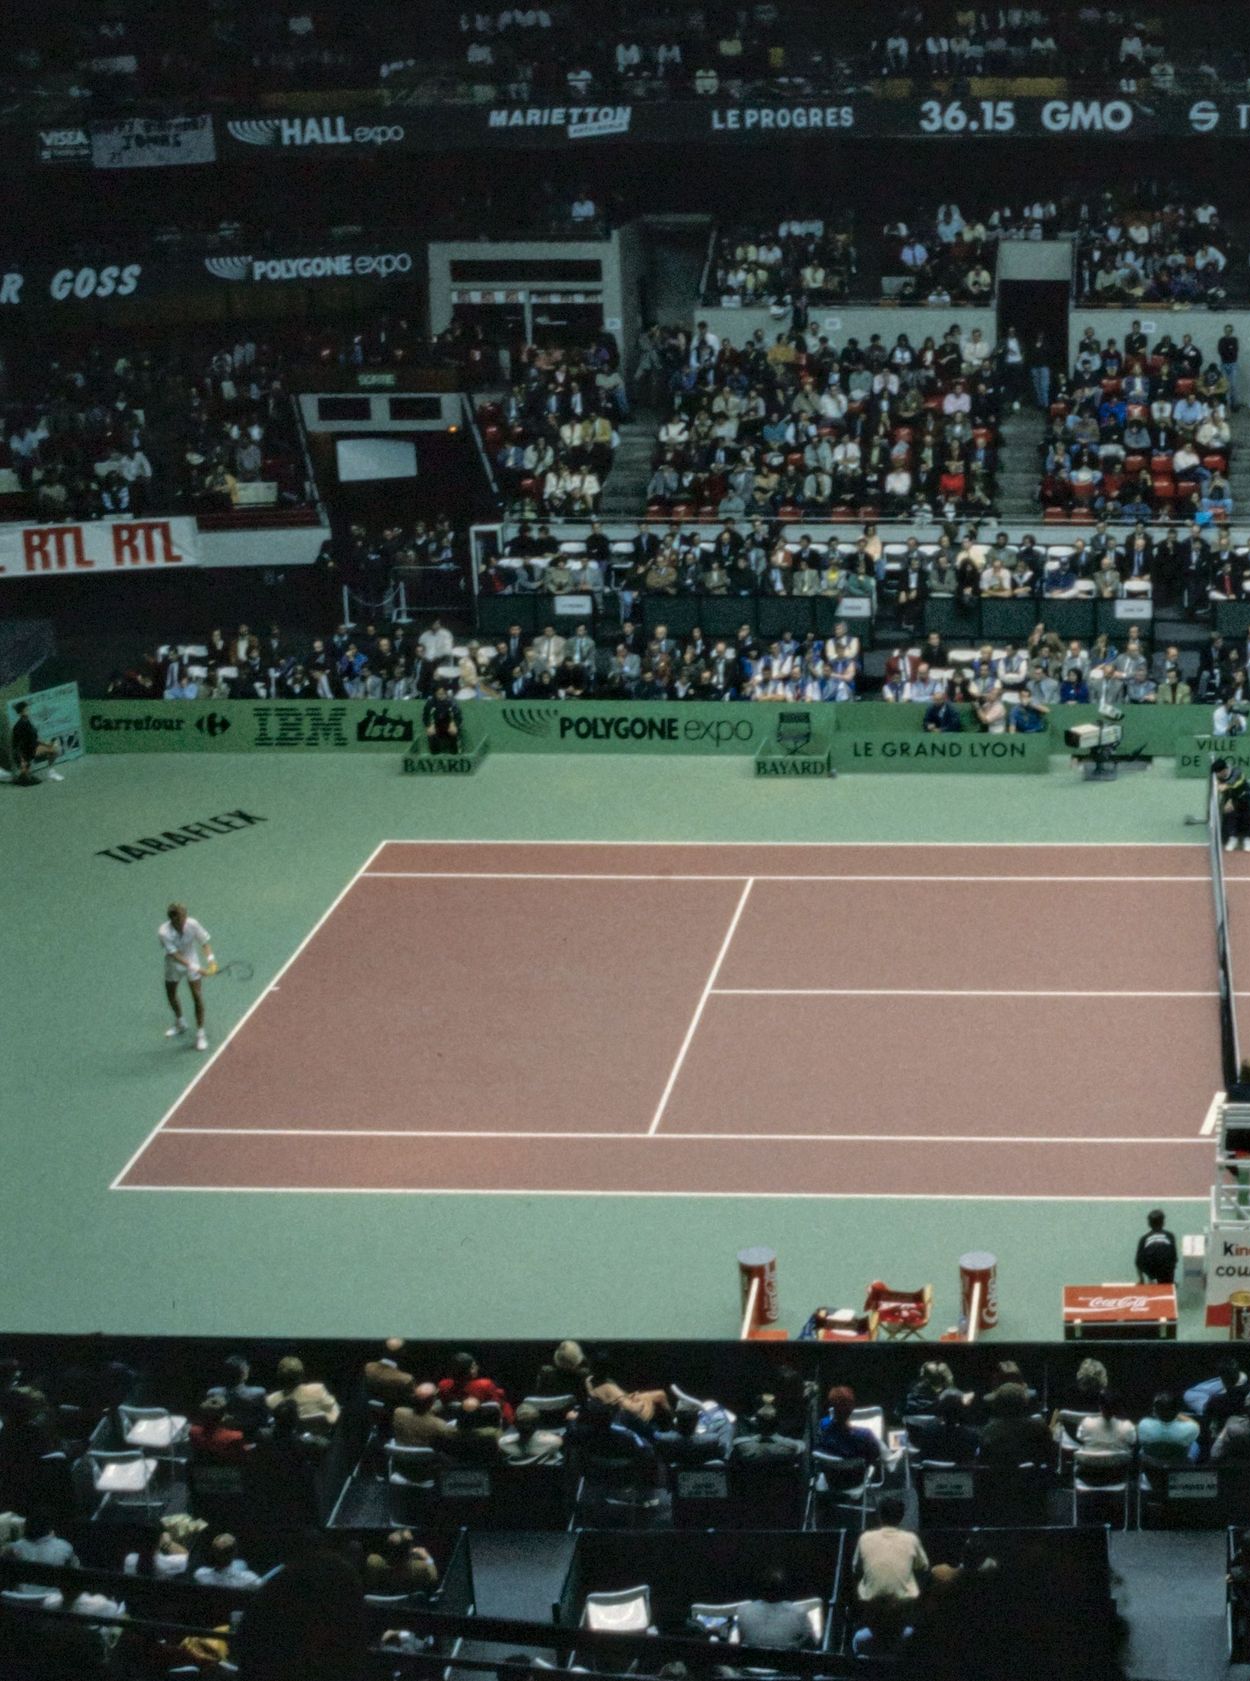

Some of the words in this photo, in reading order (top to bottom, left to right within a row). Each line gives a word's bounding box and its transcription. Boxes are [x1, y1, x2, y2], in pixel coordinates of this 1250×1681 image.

[489, 106, 632, 127] MARIETTON
[711, 109, 741, 129] LE
[744, 106, 855, 128] PROGRES
[920, 100, 1016, 131] 36.15
[1041, 100, 1133, 131] GMO
[281, 116, 352, 145] HALL
[354, 125, 405, 145] expo
[253, 255, 353, 281] POLYGONE
[354, 253, 413, 278] expo
[51, 264, 142, 300] GOSS
[23, 526, 95, 571] RTL
[112, 521, 183, 566] RTL
[89, 714, 184, 732] Carrefour
[253, 707, 347, 747] IBM
[559, 717, 679, 740] POLYGONE
[684, 719, 754, 746] expo
[852, 741, 877, 758] LE
[882, 741, 962, 758] GRAND
[970, 740, 1026, 758] LYON
[1197, 740, 1237, 752] VILLE
[403, 758, 472, 773] BAYARD
[756, 761, 826, 775] BAYARD
[1181, 755, 1201, 767] DE
[96, 809, 268, 864] TARAFLEX
